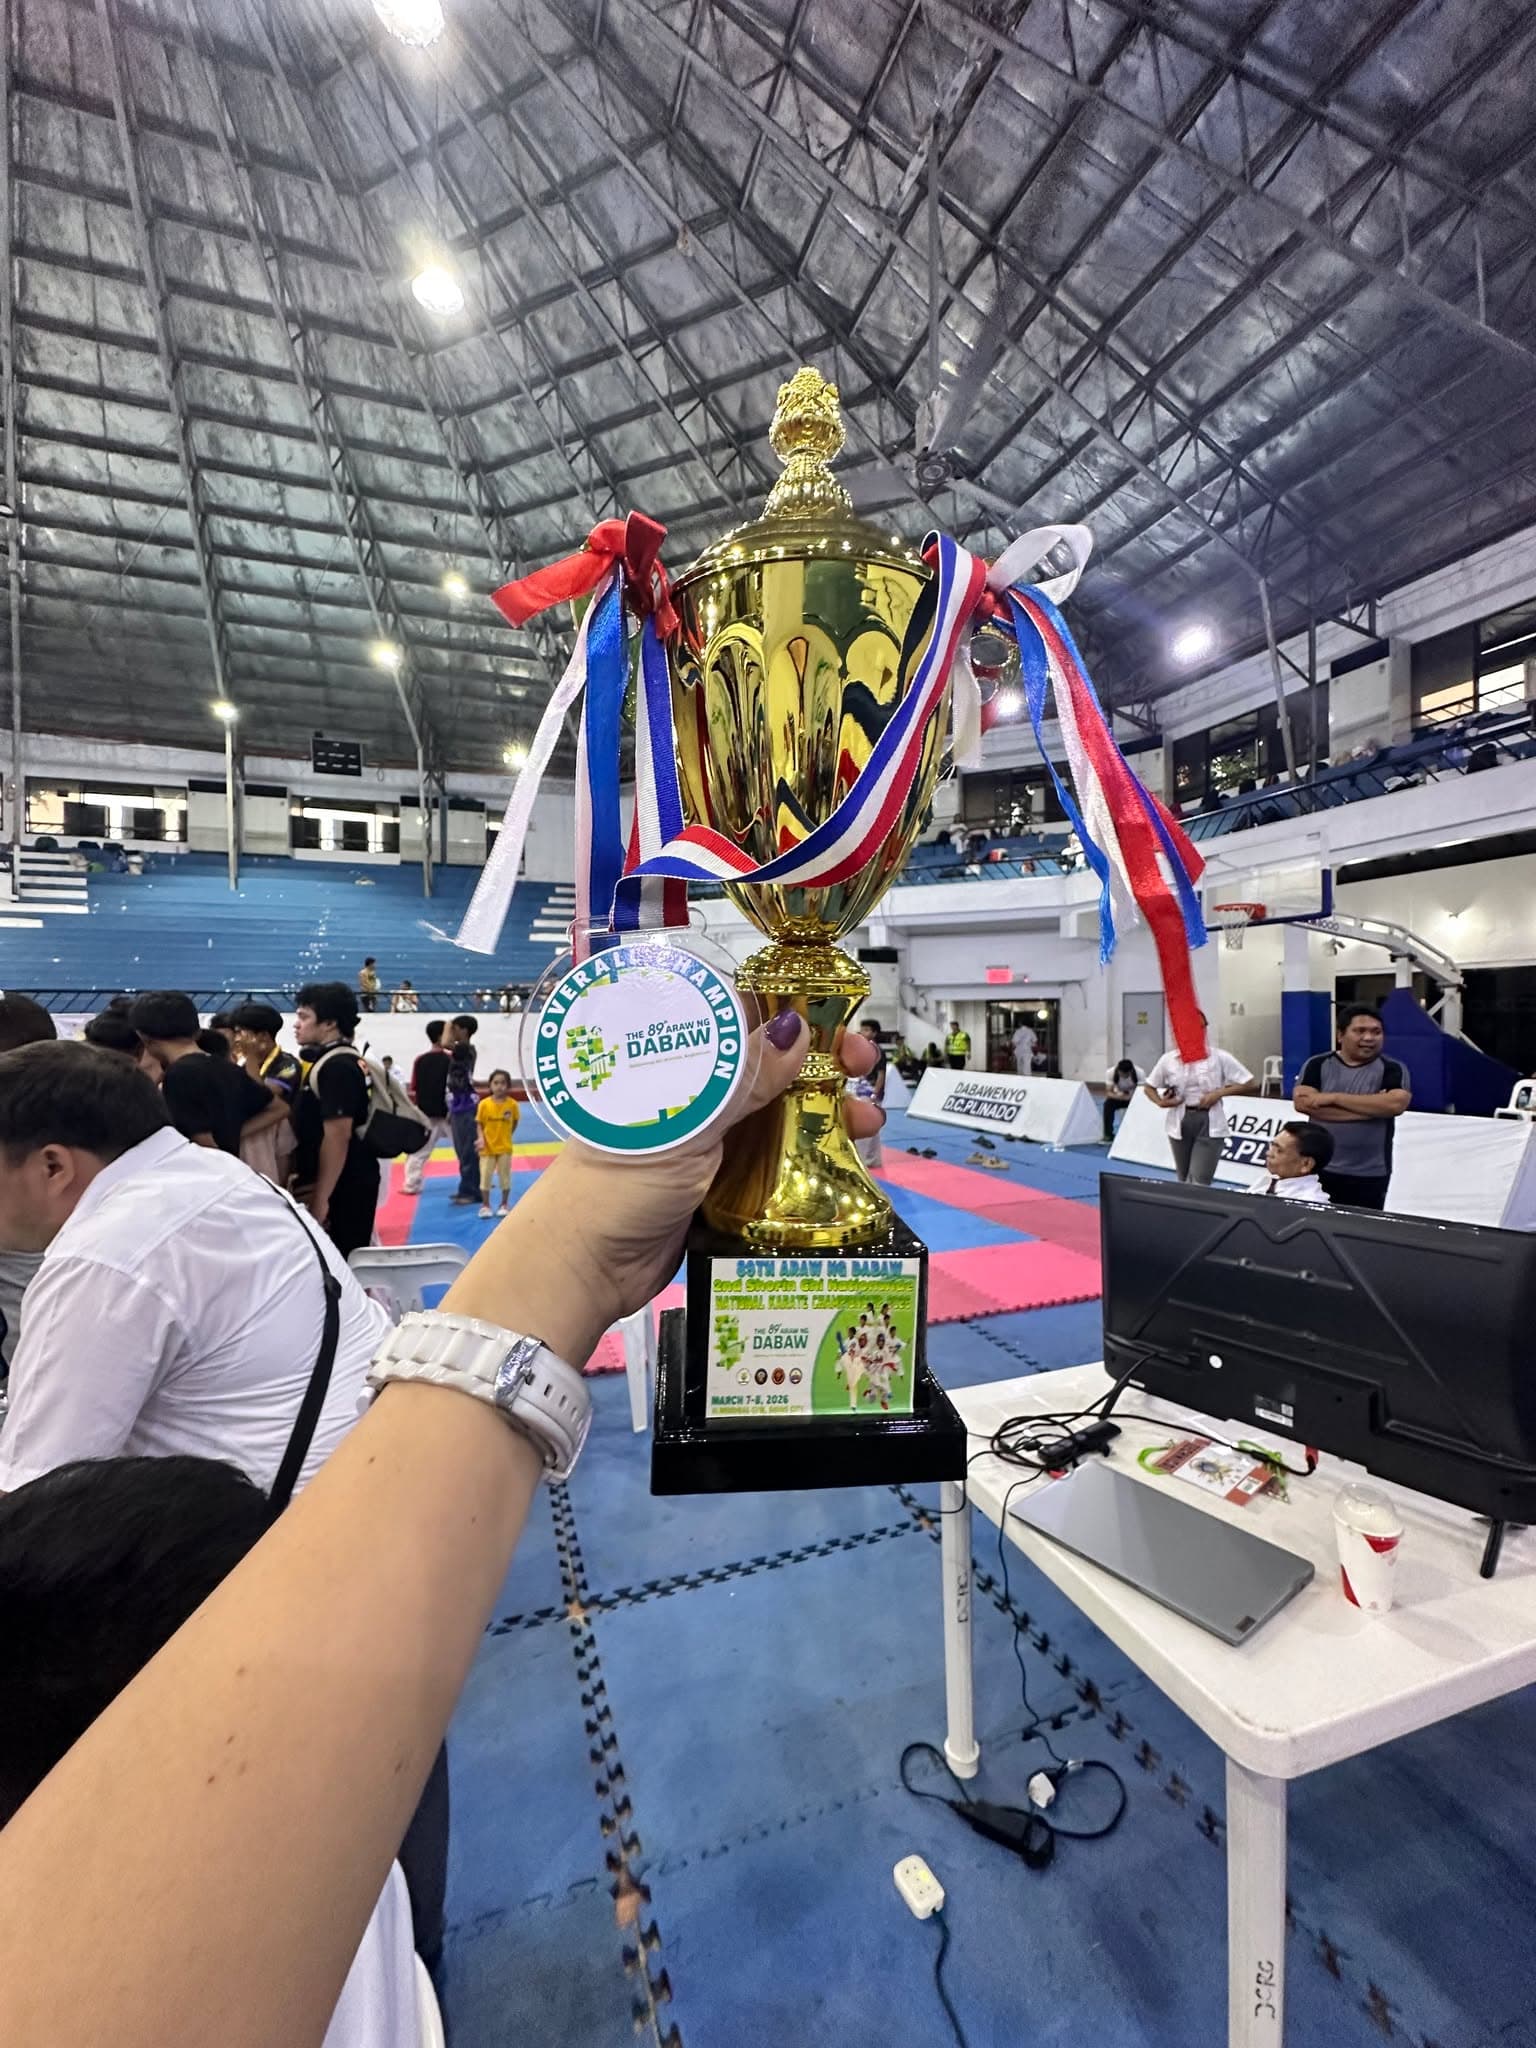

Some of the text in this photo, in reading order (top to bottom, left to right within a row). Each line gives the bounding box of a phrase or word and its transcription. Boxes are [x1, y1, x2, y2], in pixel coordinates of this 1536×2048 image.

[538, 948, 738, 1107] 5TH OVERALL CHAMPION
[625, 1030, 645, 1041] THE
[666, 1021, 694, 1034] ARAW
[696, 1017, 710, 1028] NG
[626, 1026, 711, 1059] DABAW
[953, 1081, 1028, 1103] DABAWENYO
[753, 1334, 809, 1350] DABAW
[711, 1395, 744, 1405] MARCH
